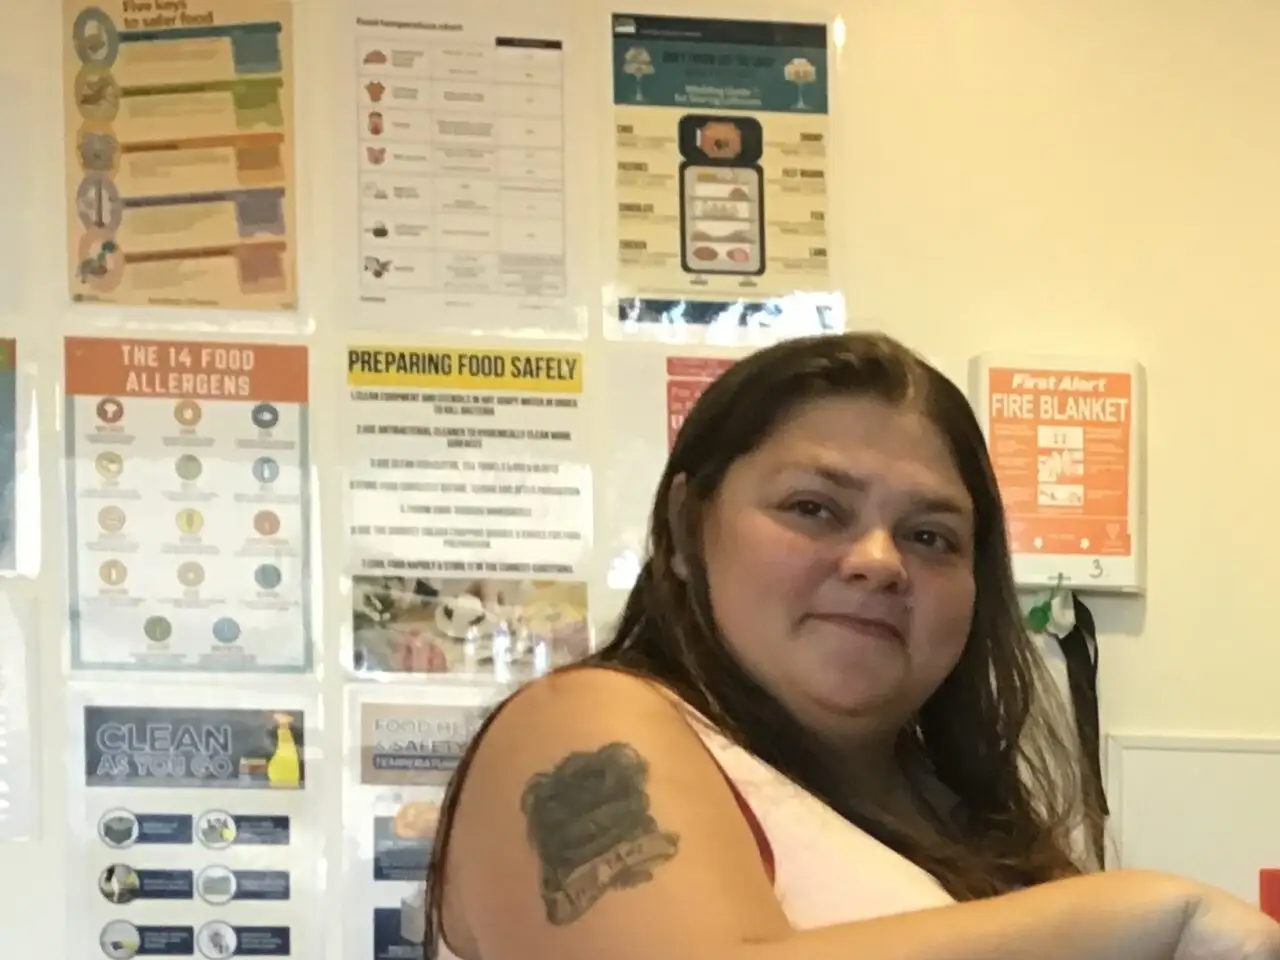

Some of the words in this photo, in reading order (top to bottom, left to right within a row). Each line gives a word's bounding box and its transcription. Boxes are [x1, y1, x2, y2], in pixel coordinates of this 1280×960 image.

[122, 0, 151, 12] Five
[155, 0, 187, 12] keys
[124, 17, 139, 28] to
[142, 13, 176, 27] safer
[180, 10, 214, 25] food
[120, 344, 158, 367] THE
[168, 346, 193, 368] 14
[200, 348, 255, 371] FOOD
[348, 349, 451, 376] PREPARING
[457, 353, 505, 378] FOOD
[511, 355, 578, 380] SAFELY
[125, 371, 251, 396] ALLERGENS
[1011, 373, 1057, 390] First
[1058, 375, 1107, 392] Alert
[991, 393, 1034, 419] FIRE
[1040, 394, 1129, 422] BLANKET
[1088, 558, 1104, 579] 3
[96, 722, 232, 753] CLEAN
[375, 719, 431, 734] FOOD
[97, 754, 129, 776] AS
[132, 754, 185, 777] YOU
[190, 755, 234, 778] GO
